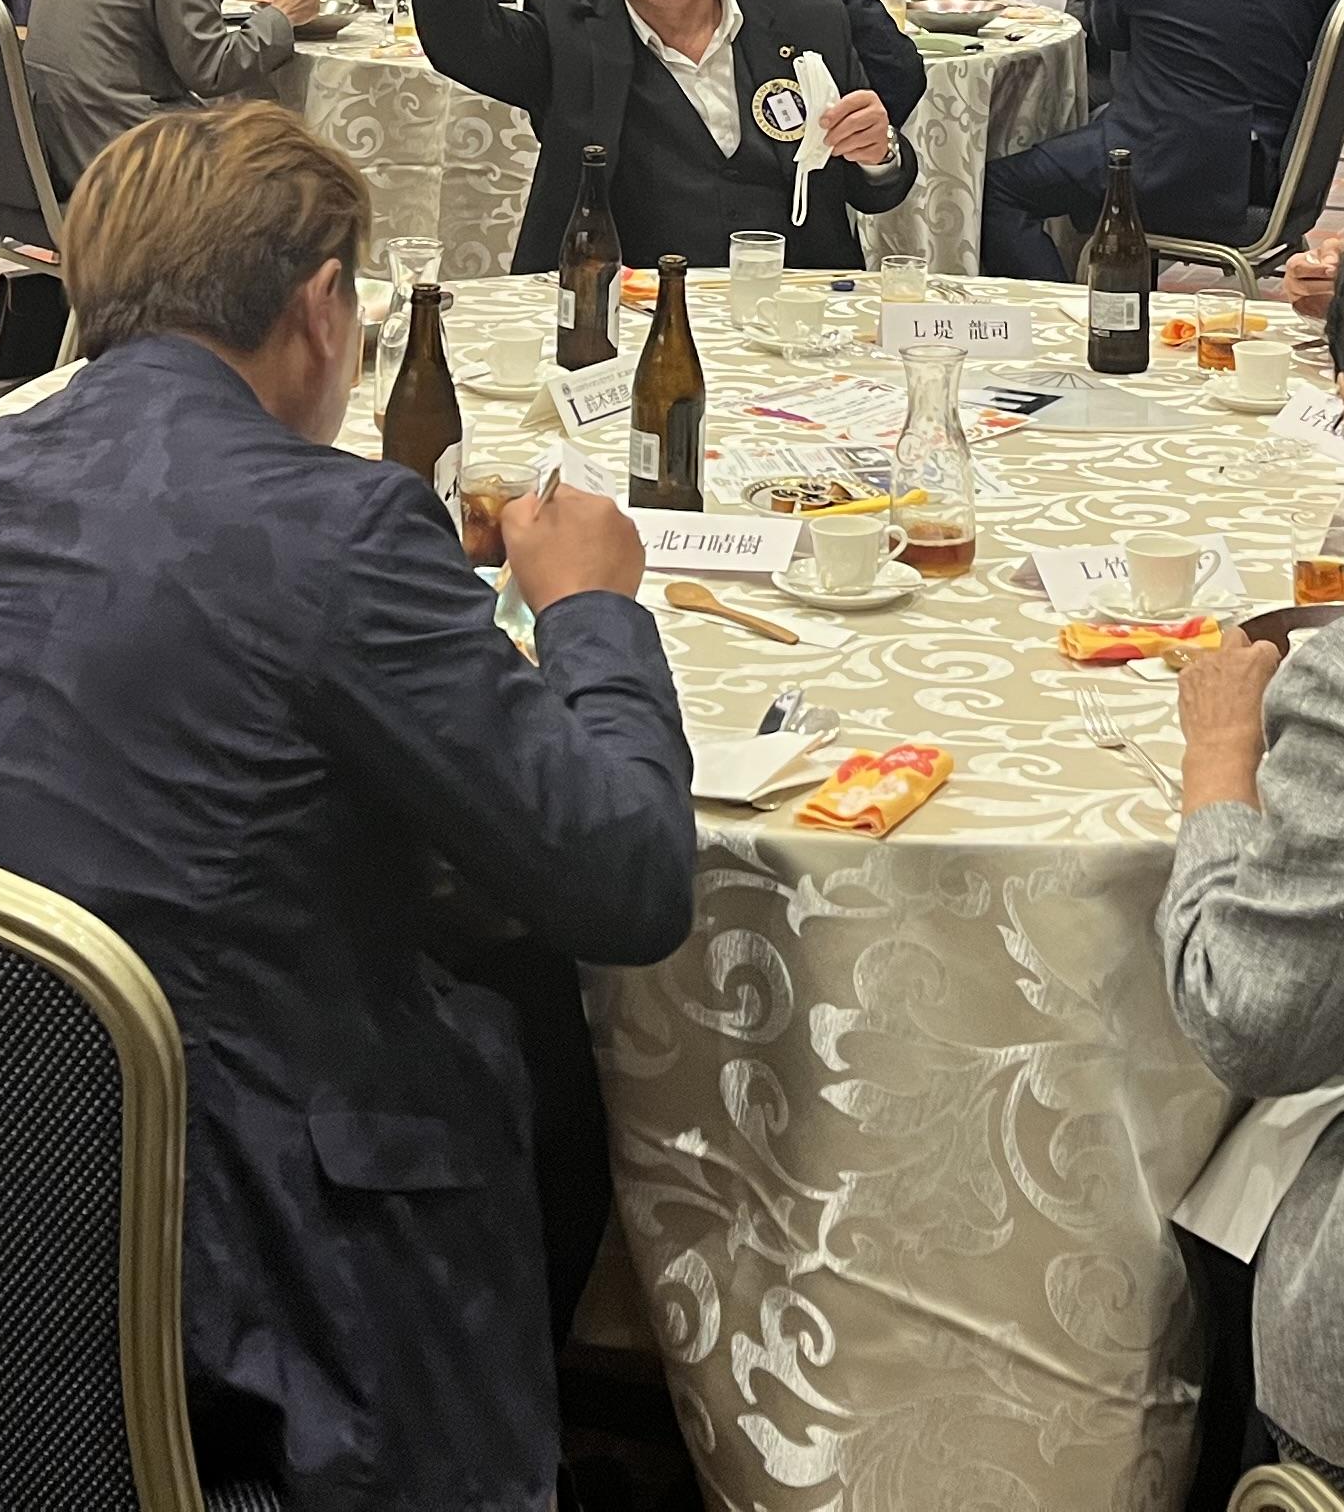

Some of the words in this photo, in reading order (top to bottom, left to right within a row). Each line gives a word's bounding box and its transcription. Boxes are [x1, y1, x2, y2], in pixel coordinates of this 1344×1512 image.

[914, 320, 926, 338] L
[969, 319, 1009, 340] 龍司
[653, 529, 763, 555] 北口晴樹
